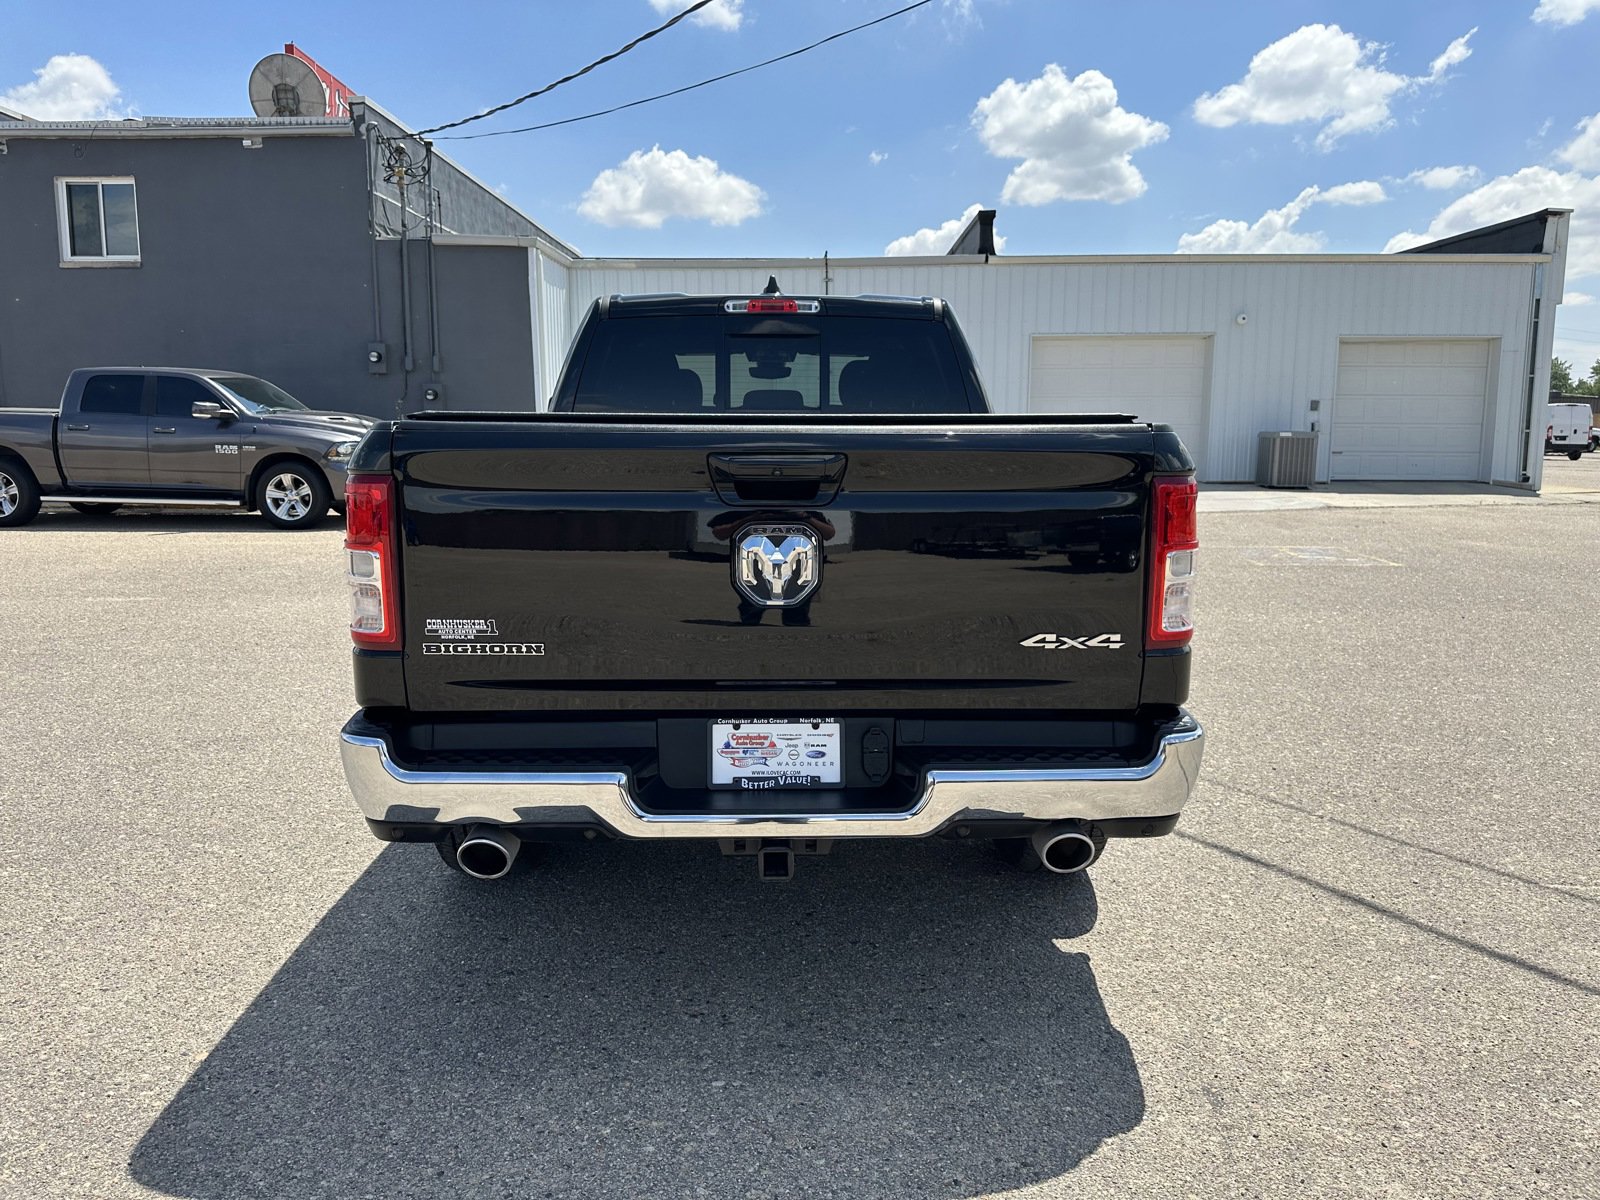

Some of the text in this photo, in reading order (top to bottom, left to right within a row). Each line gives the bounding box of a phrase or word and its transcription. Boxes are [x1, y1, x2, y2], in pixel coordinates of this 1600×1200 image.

[752, 526, 803, 534] RAM
[426, 619, 487, 629] CORNHUSKER
[1019, 633, 1126, 649] 4x4
[422, 643, 545, 656] BIGHORN
[731, 733, 769, 741] Cornhusker
[741, 774, 811, 790] BETTER VALUE!
